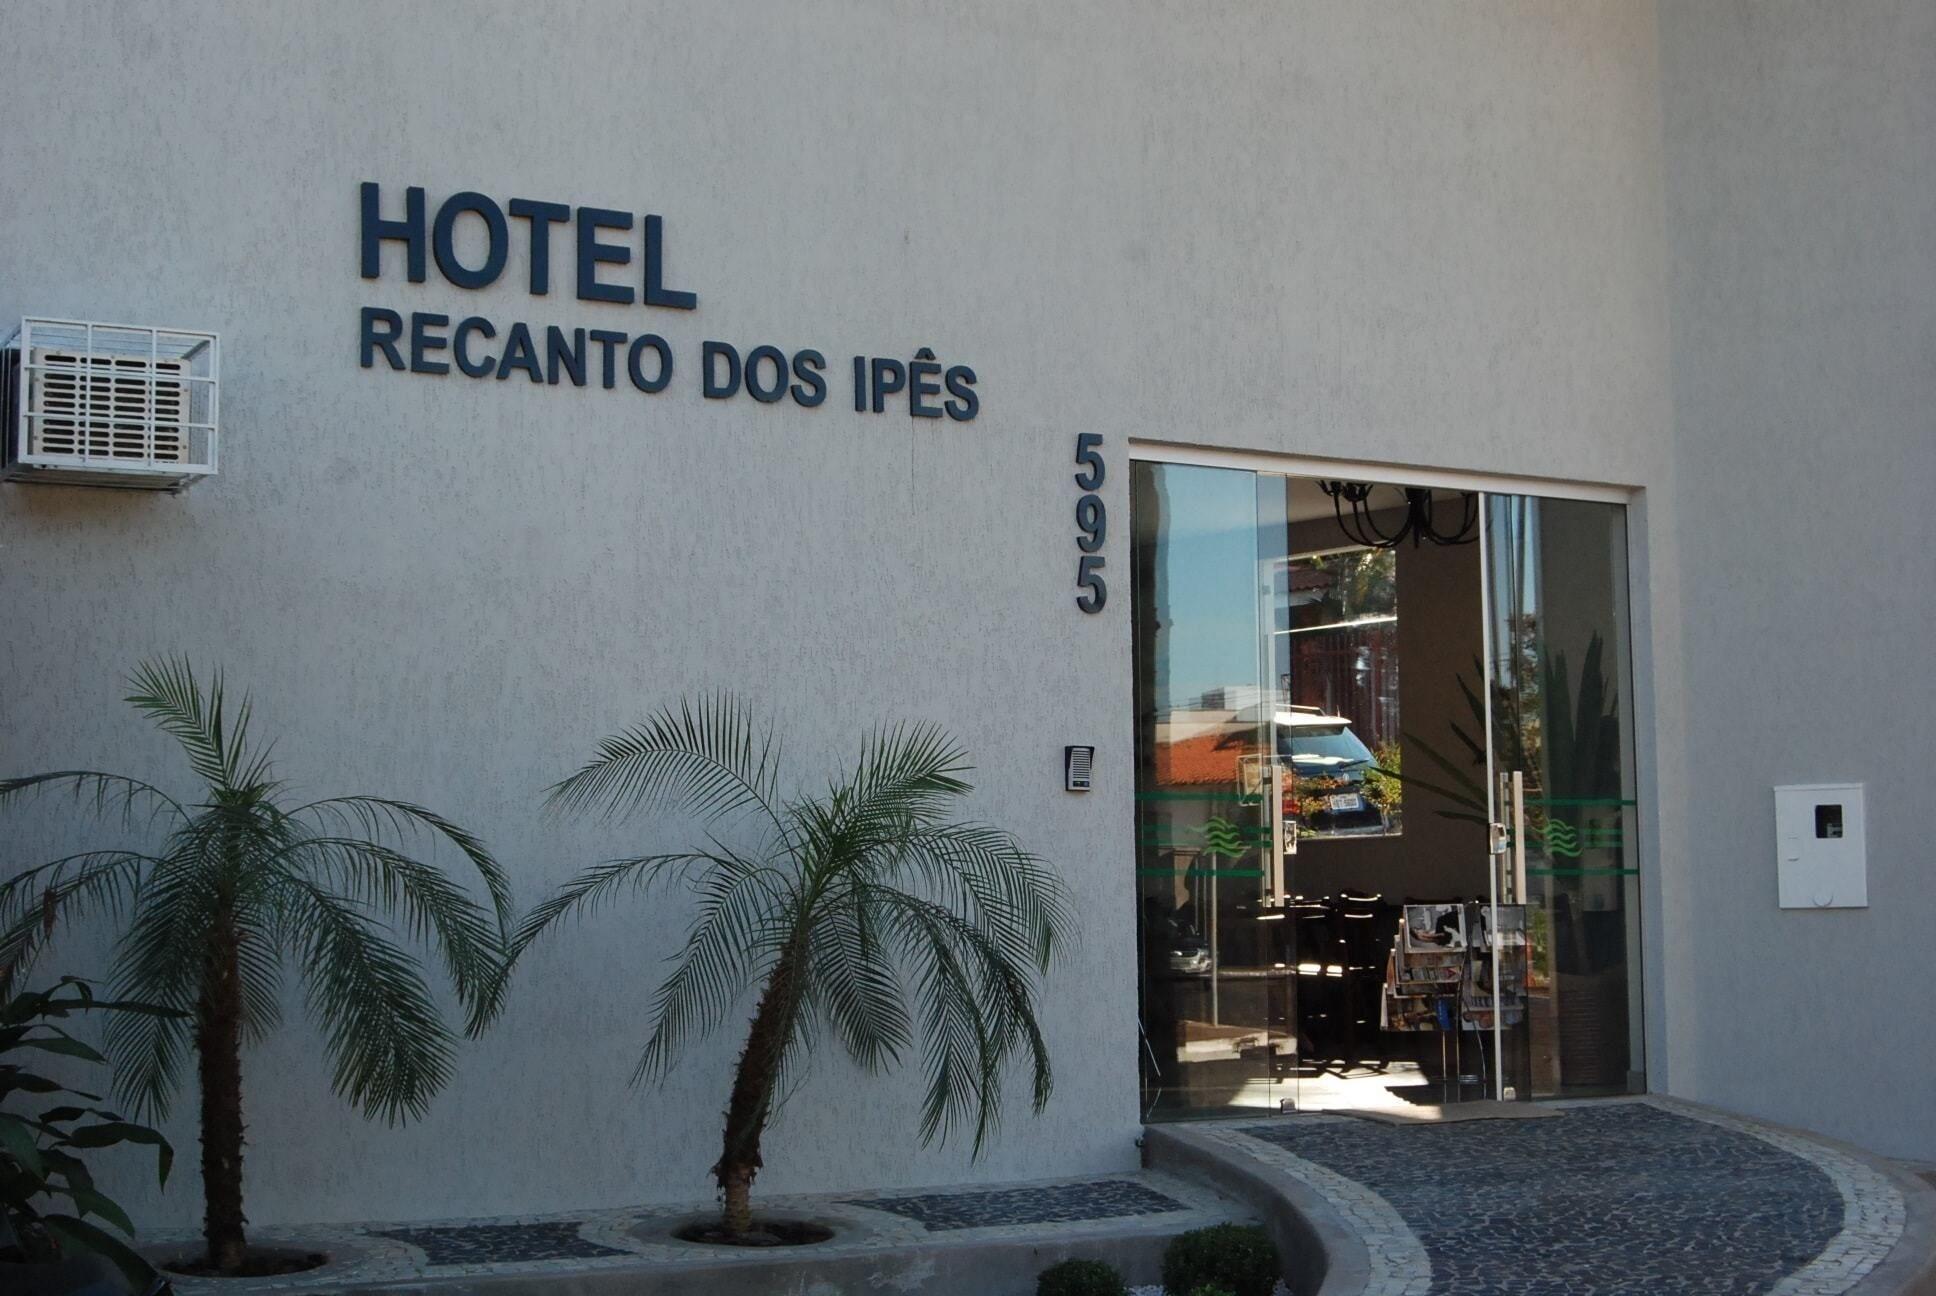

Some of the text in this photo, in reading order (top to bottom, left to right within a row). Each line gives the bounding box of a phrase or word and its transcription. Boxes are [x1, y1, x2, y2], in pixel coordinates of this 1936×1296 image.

[360, 182, 697, 311] HOTEL
[360, 307, 980, 423] RECANTO DOS IPÊS
[1074, 432, 1108, 616] 595
